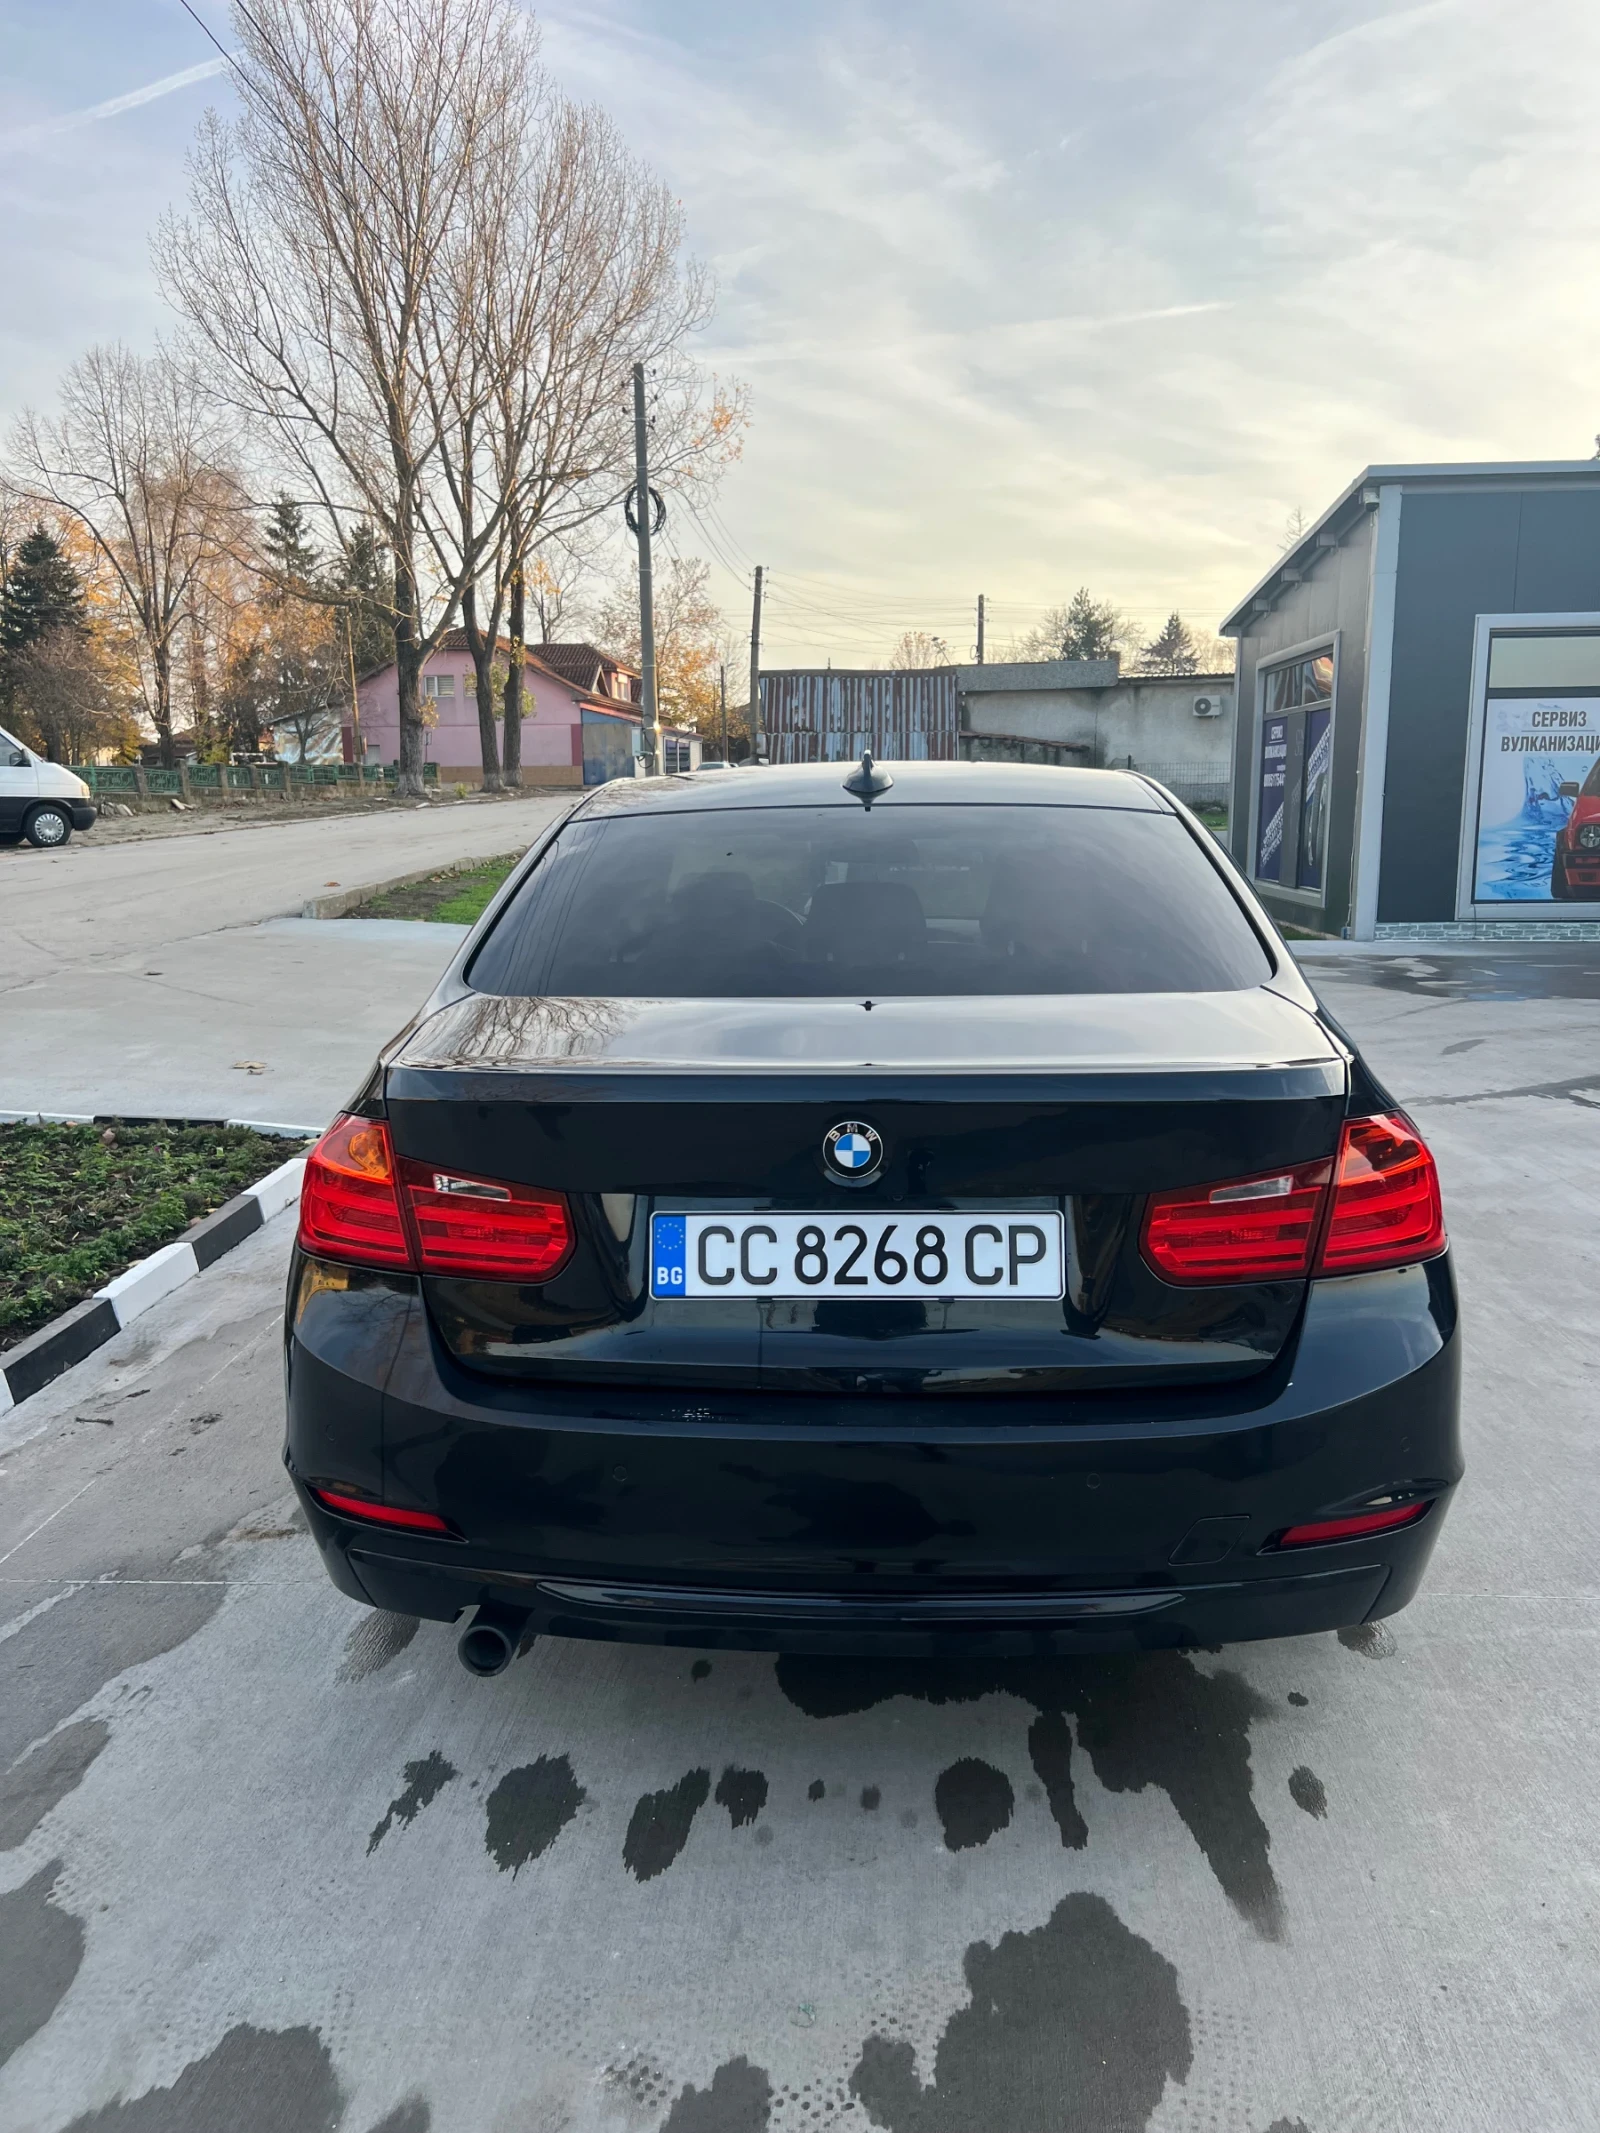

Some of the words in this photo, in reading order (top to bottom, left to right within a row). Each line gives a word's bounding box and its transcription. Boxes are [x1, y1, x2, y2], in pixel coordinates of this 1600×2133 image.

[1532, 711, 1587, 727] СЕРВИЗ
[828, 1123, 878, 1142] BMW
[698, 1225, 778, 1286] CC
[795, 1225, 948, 1285] 8268
[965, 1225, 1047, 1286] CP
[656, 1267, 683, 1285] BG
